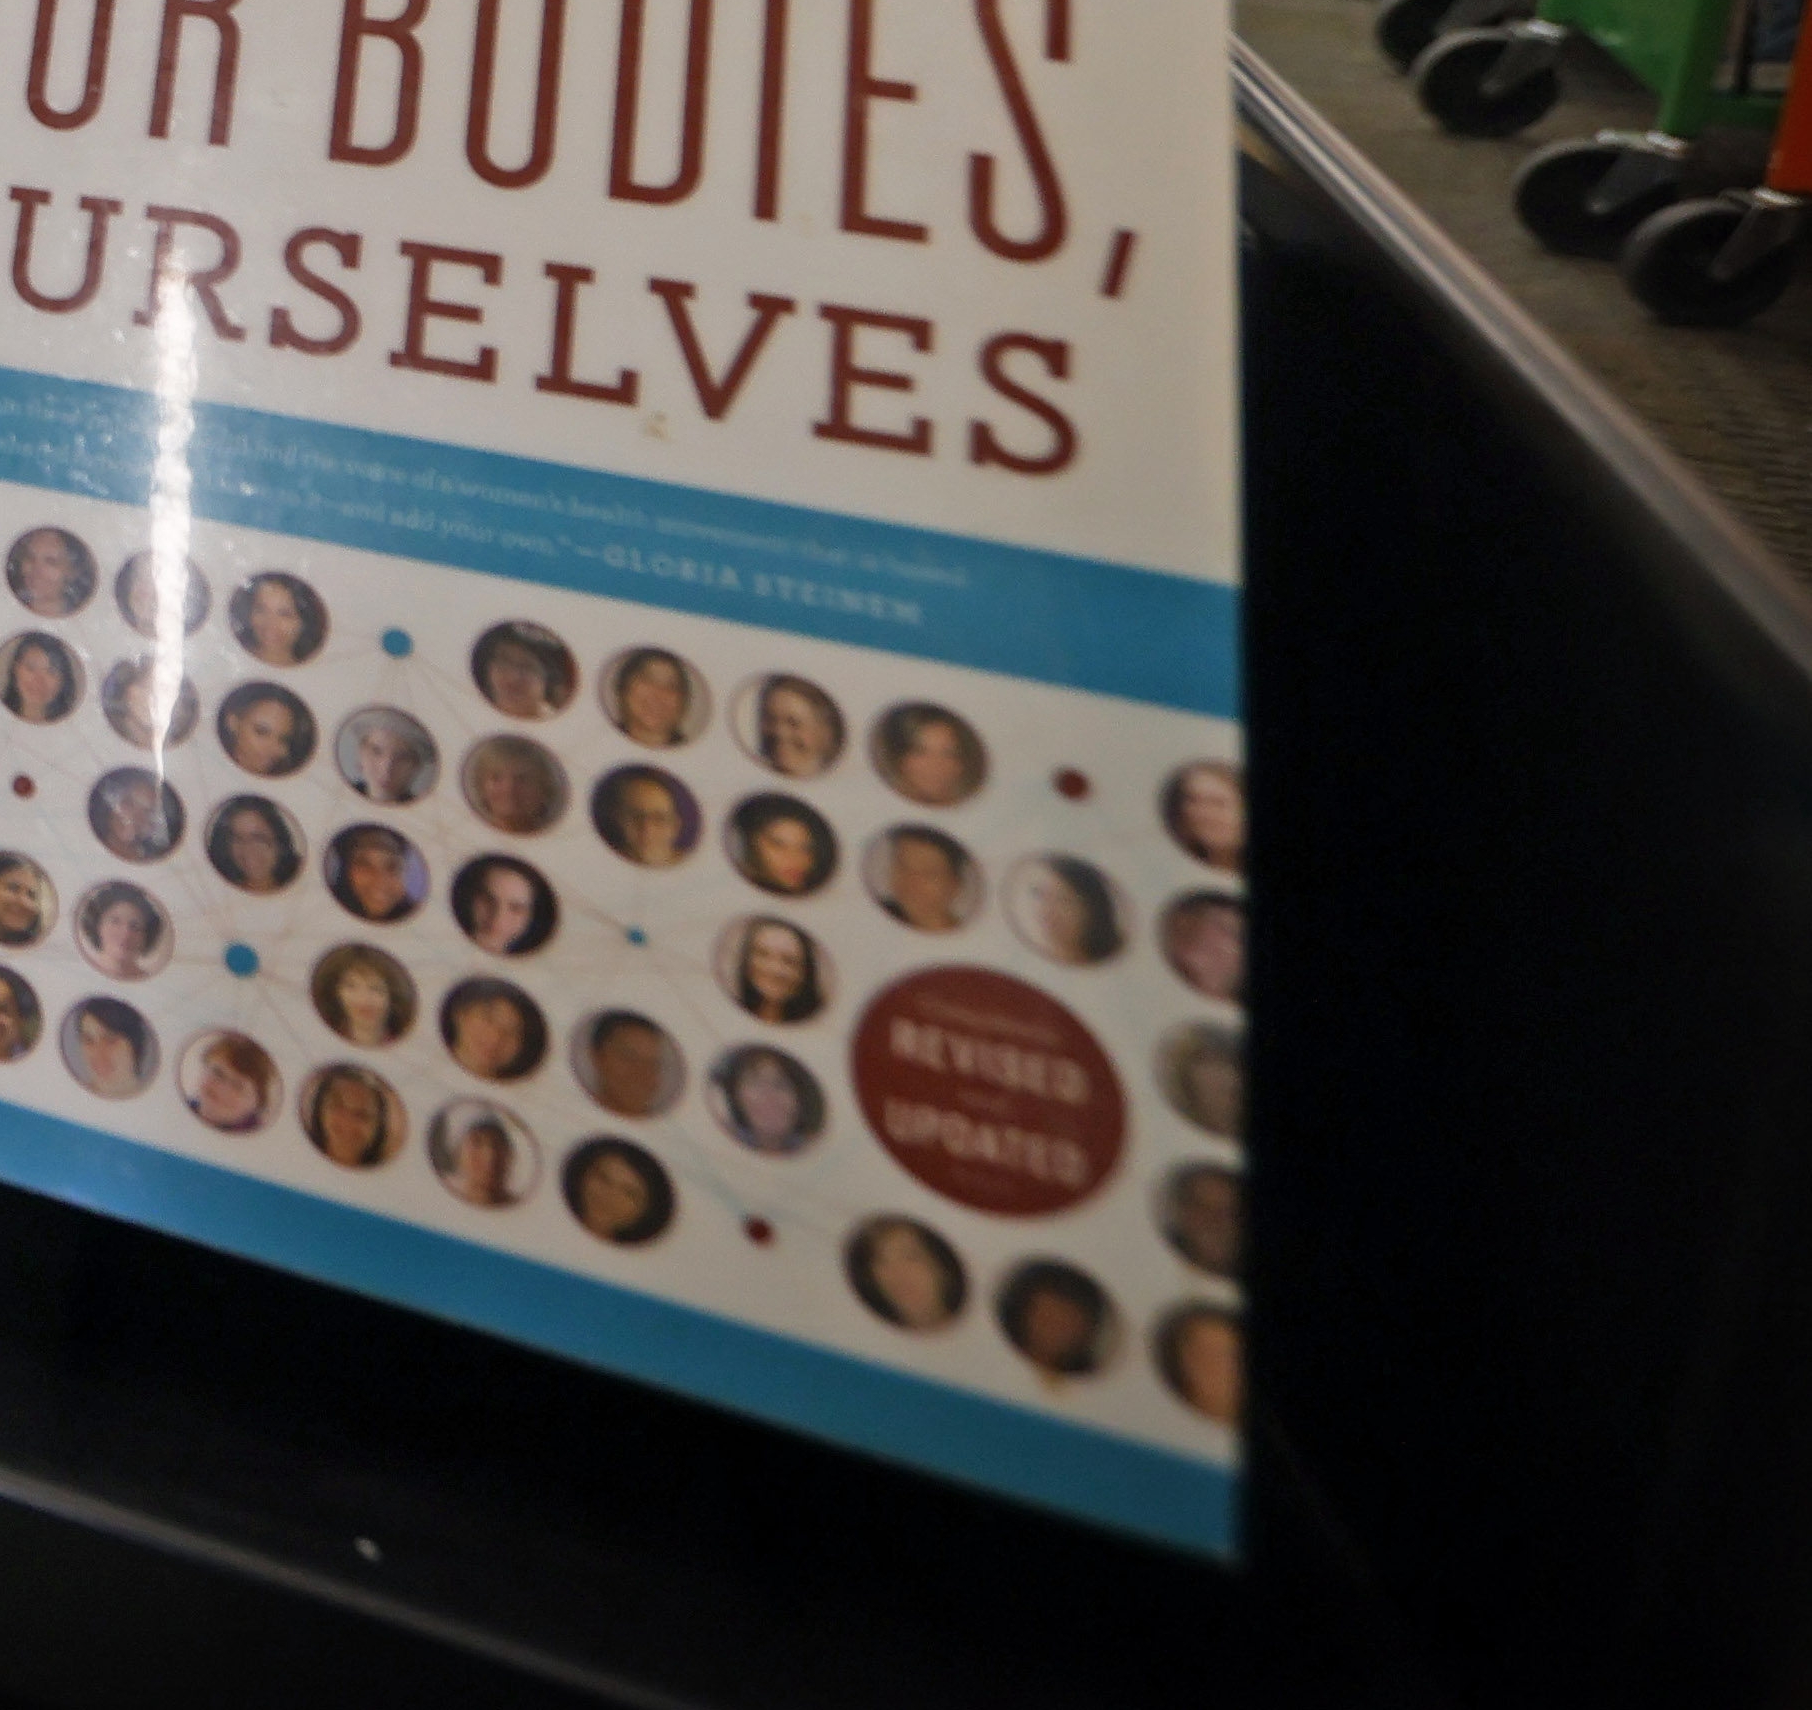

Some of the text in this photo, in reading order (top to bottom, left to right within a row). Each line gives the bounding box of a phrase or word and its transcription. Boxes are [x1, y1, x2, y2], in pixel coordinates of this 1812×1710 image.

[755, 573, 923, 627] STEINEM
[888, 1016, 1091, 1106] REVISED
[883, 1098, 1091, 1188] UPDATED
